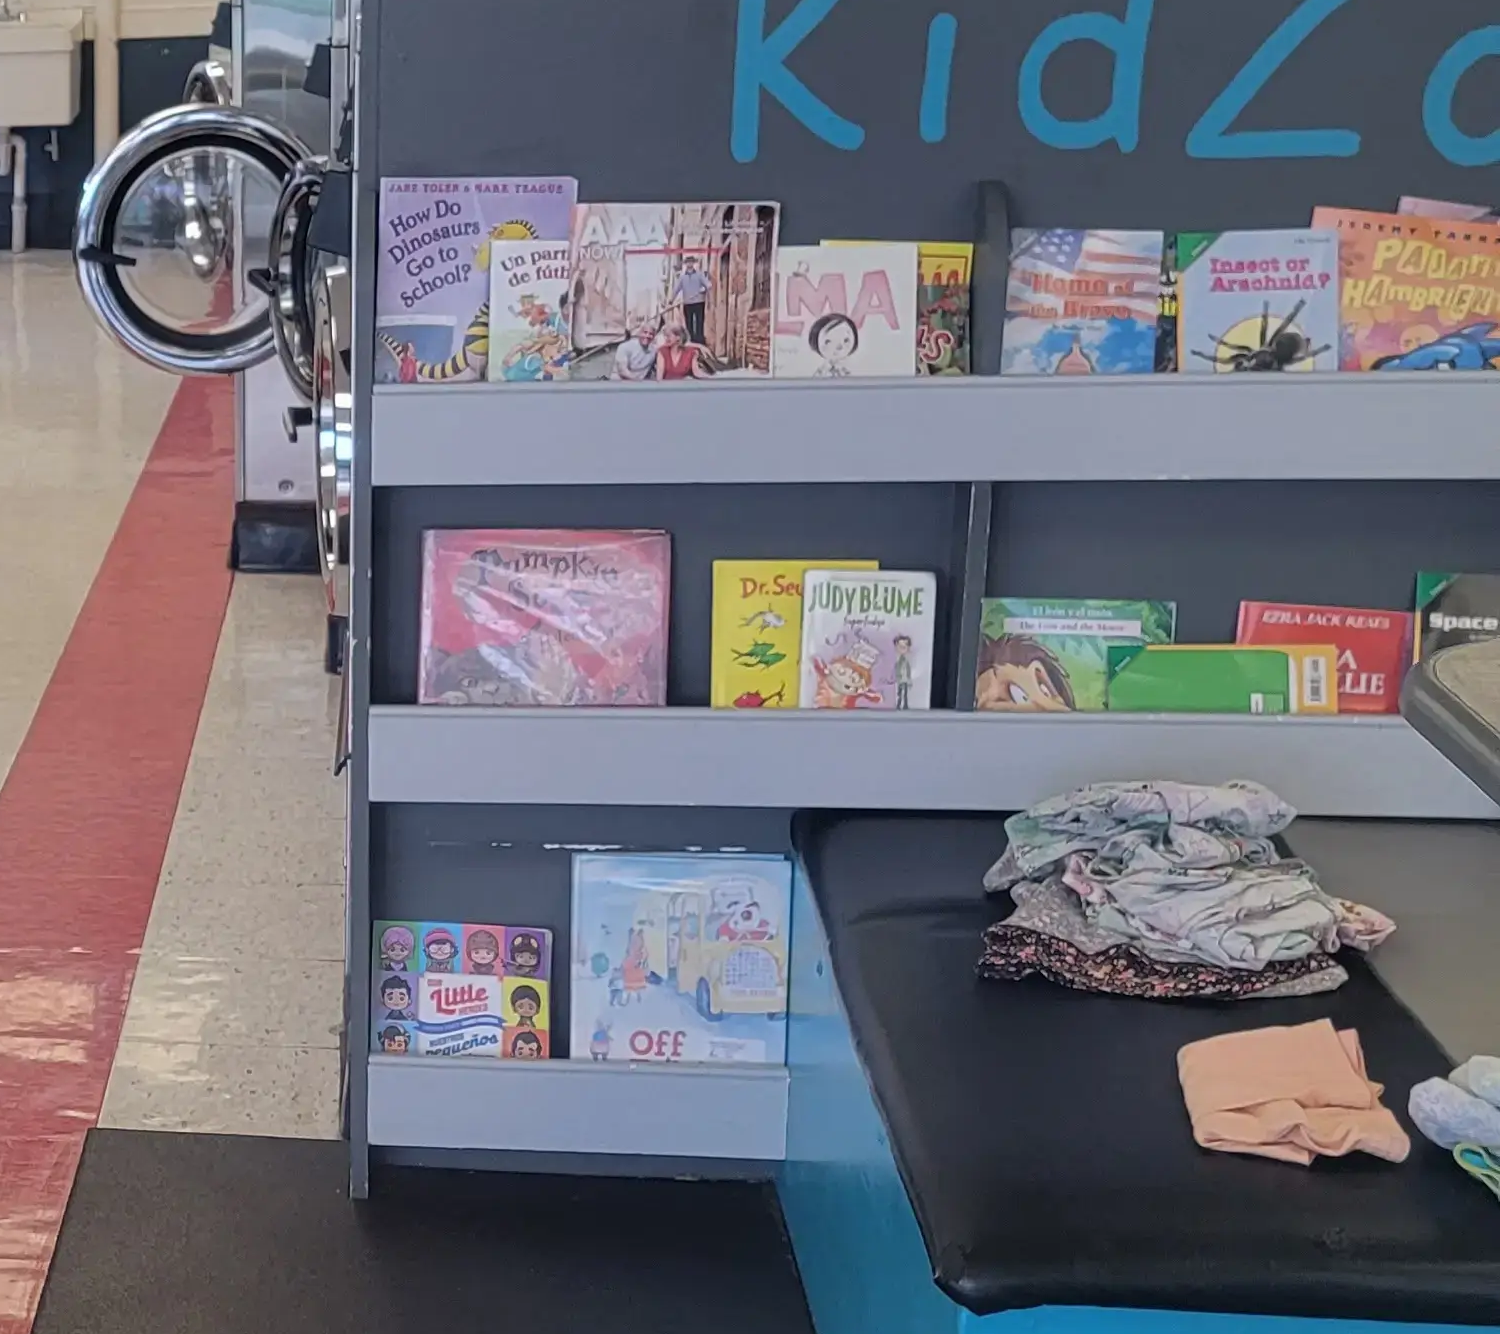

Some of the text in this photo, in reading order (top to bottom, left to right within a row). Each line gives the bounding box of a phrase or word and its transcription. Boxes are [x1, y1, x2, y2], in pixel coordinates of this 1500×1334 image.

[389, 199, 462, 238] How Do
[581, 215, 669, 246] AAA
[387, 221, 481, 265] Dinosaurs
[406, 246, 459, 277] Go to
[500, 253, 526, 272] Un
[1210, 257, 1310, 274] Insect or
[508, 271, 531, 288] de
[1210, 273, 1331, 292] Arachnid?
[740, 577, 770, 598] Dr.
[808, 581, 924, 616] JUDY BLUME
[1060, 622, 1077, 632] and
[1307, 612, 1341, 627] JACK
[1429, 612, 1498, 633] Space
[429, 983, 489, 1015] Little
[629, 1030, 687, 1057] Off
